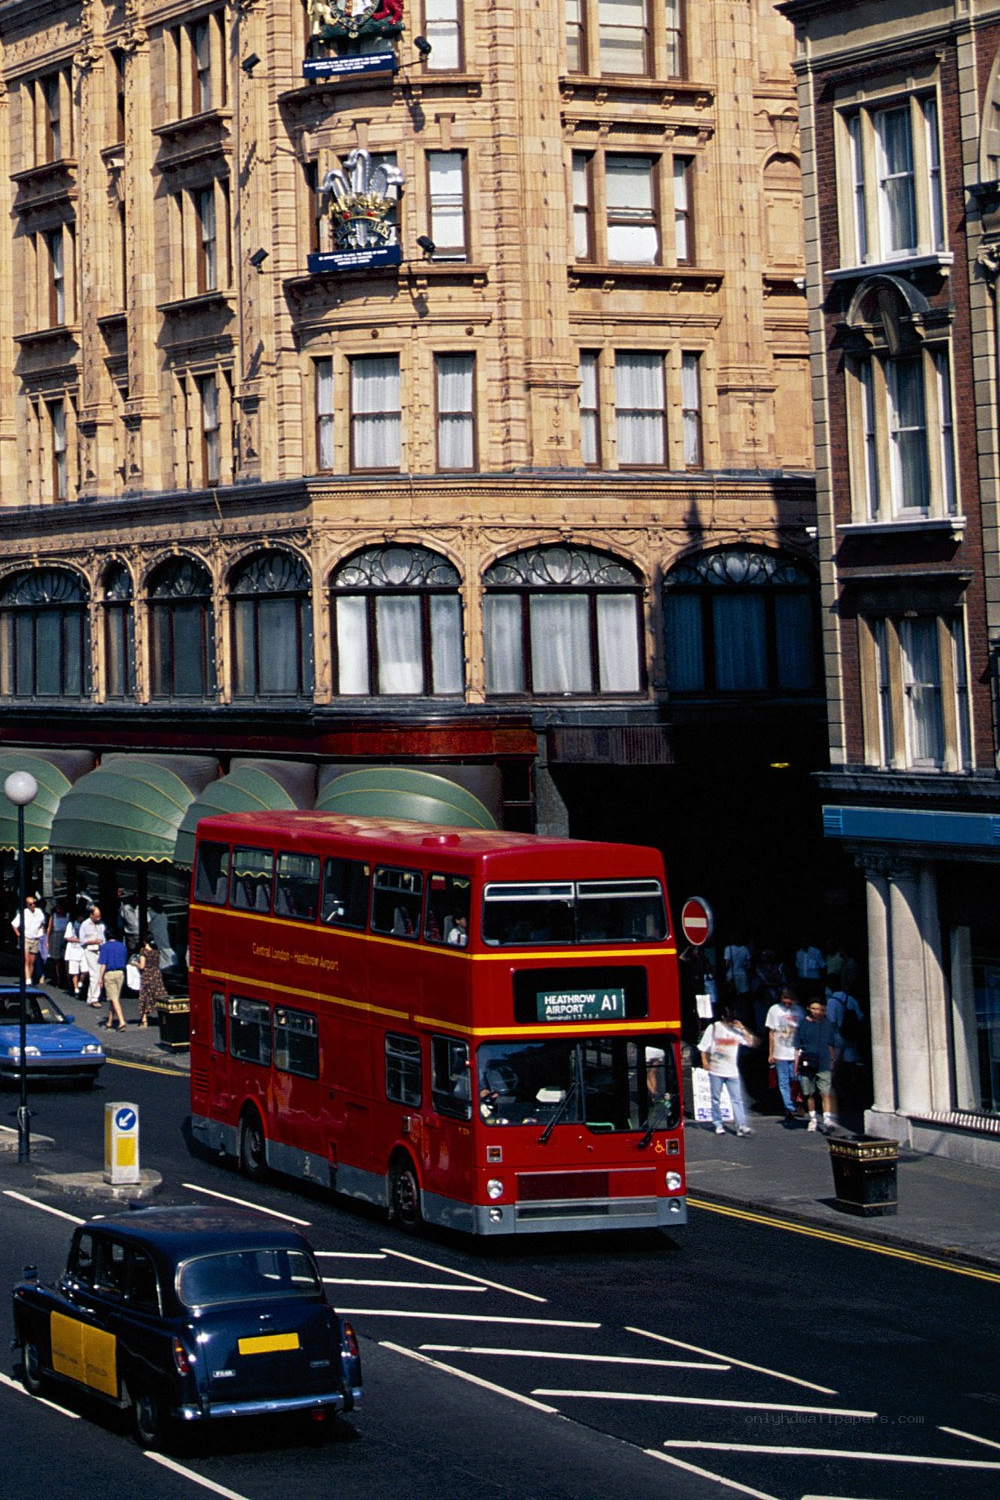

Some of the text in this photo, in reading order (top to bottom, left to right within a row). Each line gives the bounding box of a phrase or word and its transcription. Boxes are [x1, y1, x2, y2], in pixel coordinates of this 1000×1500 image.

[252, 942, 271, 958] Central
[271, 946, 290, 961] London
[544, 994, 596, 1005] HEATHROW
[601, 994, 617, 1011] A1
[545, 1004, 584, 1015] AIRPORT
